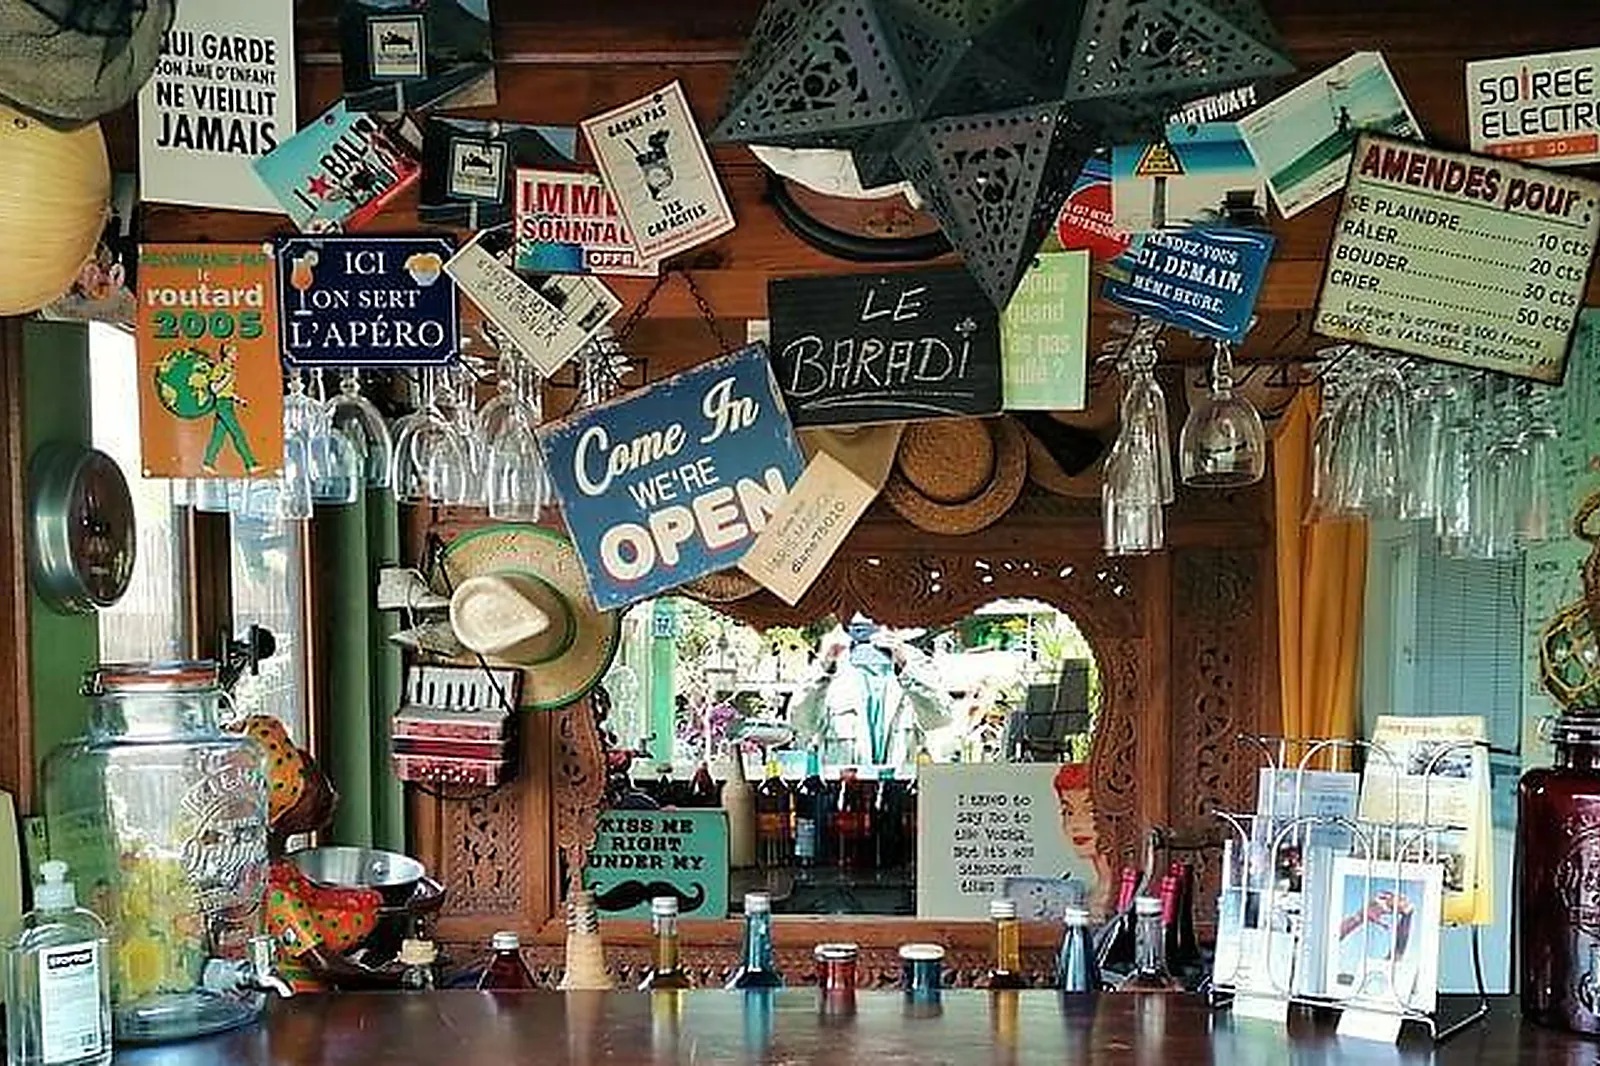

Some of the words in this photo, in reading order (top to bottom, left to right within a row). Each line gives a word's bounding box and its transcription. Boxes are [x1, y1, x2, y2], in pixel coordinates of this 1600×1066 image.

[202, 34, 275, 65] GARDE
[216, 66, 276, 85] D'ENFANT
[1480, 66, 1593, 105] SOIREE
[156, 82, 184, 107] NE
[192, 85, 277, 116] VIEILLIT
[157, 112, 277, 156] JAMAIS
[1482, 102, 1600, 138] ELECTR
[1359, 144, 1502, 202] AMENDES
[1504, 178, 1582, 217] pour
[1350, 195, 1370, 213] SE
[1536, 233, 1559, 251] 10
[1562, 236, 1591, 259] cts
[344, 252, 386, 275] ICI
[1163, 255, 1244, 296] DEMAIN,
[1336, 245, 1409, 272] BOUDER
[1522, 283, 1546, 301] 30
[1549, 287, 1578, 310] cts
[1528, 258, 1552, 276] 20
[1555, 262, 1584, 284] cts
[146, 283, 264, 307] routard
[312, 290, 349, 309] ON
[358, 289, 421, 309] SERT
[860, 286, 927, 322] LE
[150, 309, 264, 339] 2005
[289, 314, 444, 348] L'APÉRO
[1515, 308, 1541, 327] 50
[1542, 312, 1573, 335] cts
[574, 424, 686, 495] Come
[701, 376, 759, 444] In
[628, 456, 720, 509] WE'RE
[600, 466, 788, 582] OPEN
[600, 818, 654, 833] KISS
[661, 818, 695, 834] ME
[611, 836, 682, 852] RIGHT
[588, 853, 663, 869] UNDER
[671, 854, 705, 871] MY
